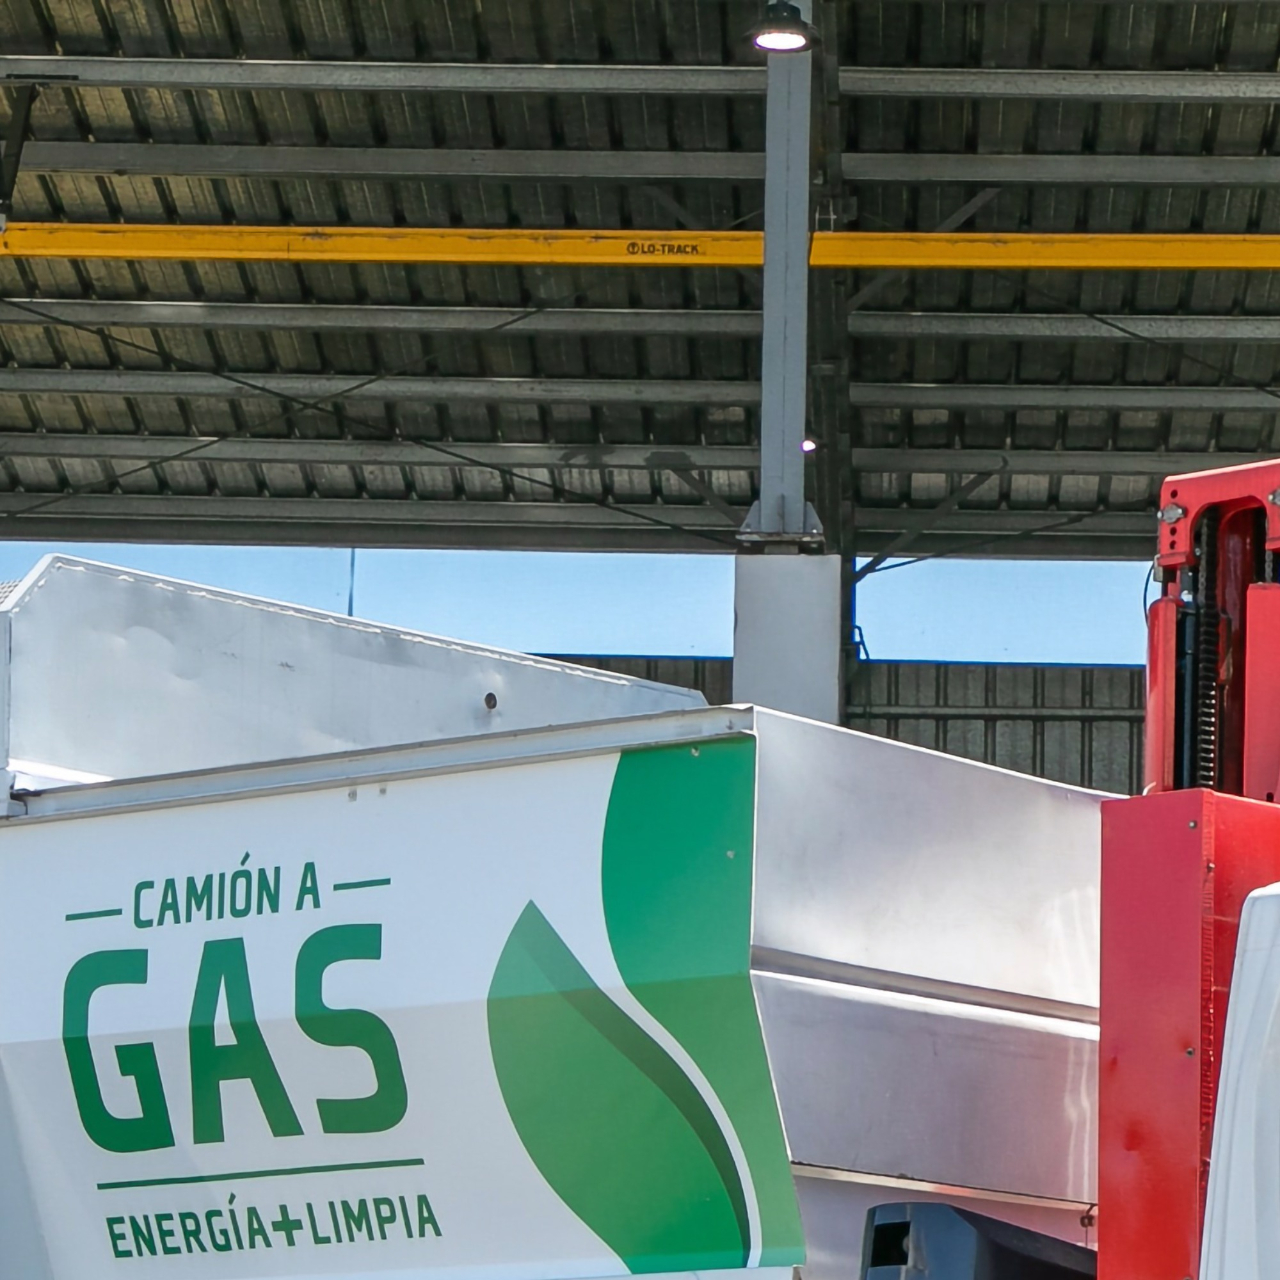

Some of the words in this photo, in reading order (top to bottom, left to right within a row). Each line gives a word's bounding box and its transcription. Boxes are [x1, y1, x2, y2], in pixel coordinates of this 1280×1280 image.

[640, 242, 699, 255] LO-TRACK
[133, 851, 281, 929] CAMIÓN
[295, 861, 321, 911] A
[62, 923, 408, 1153] GAS
